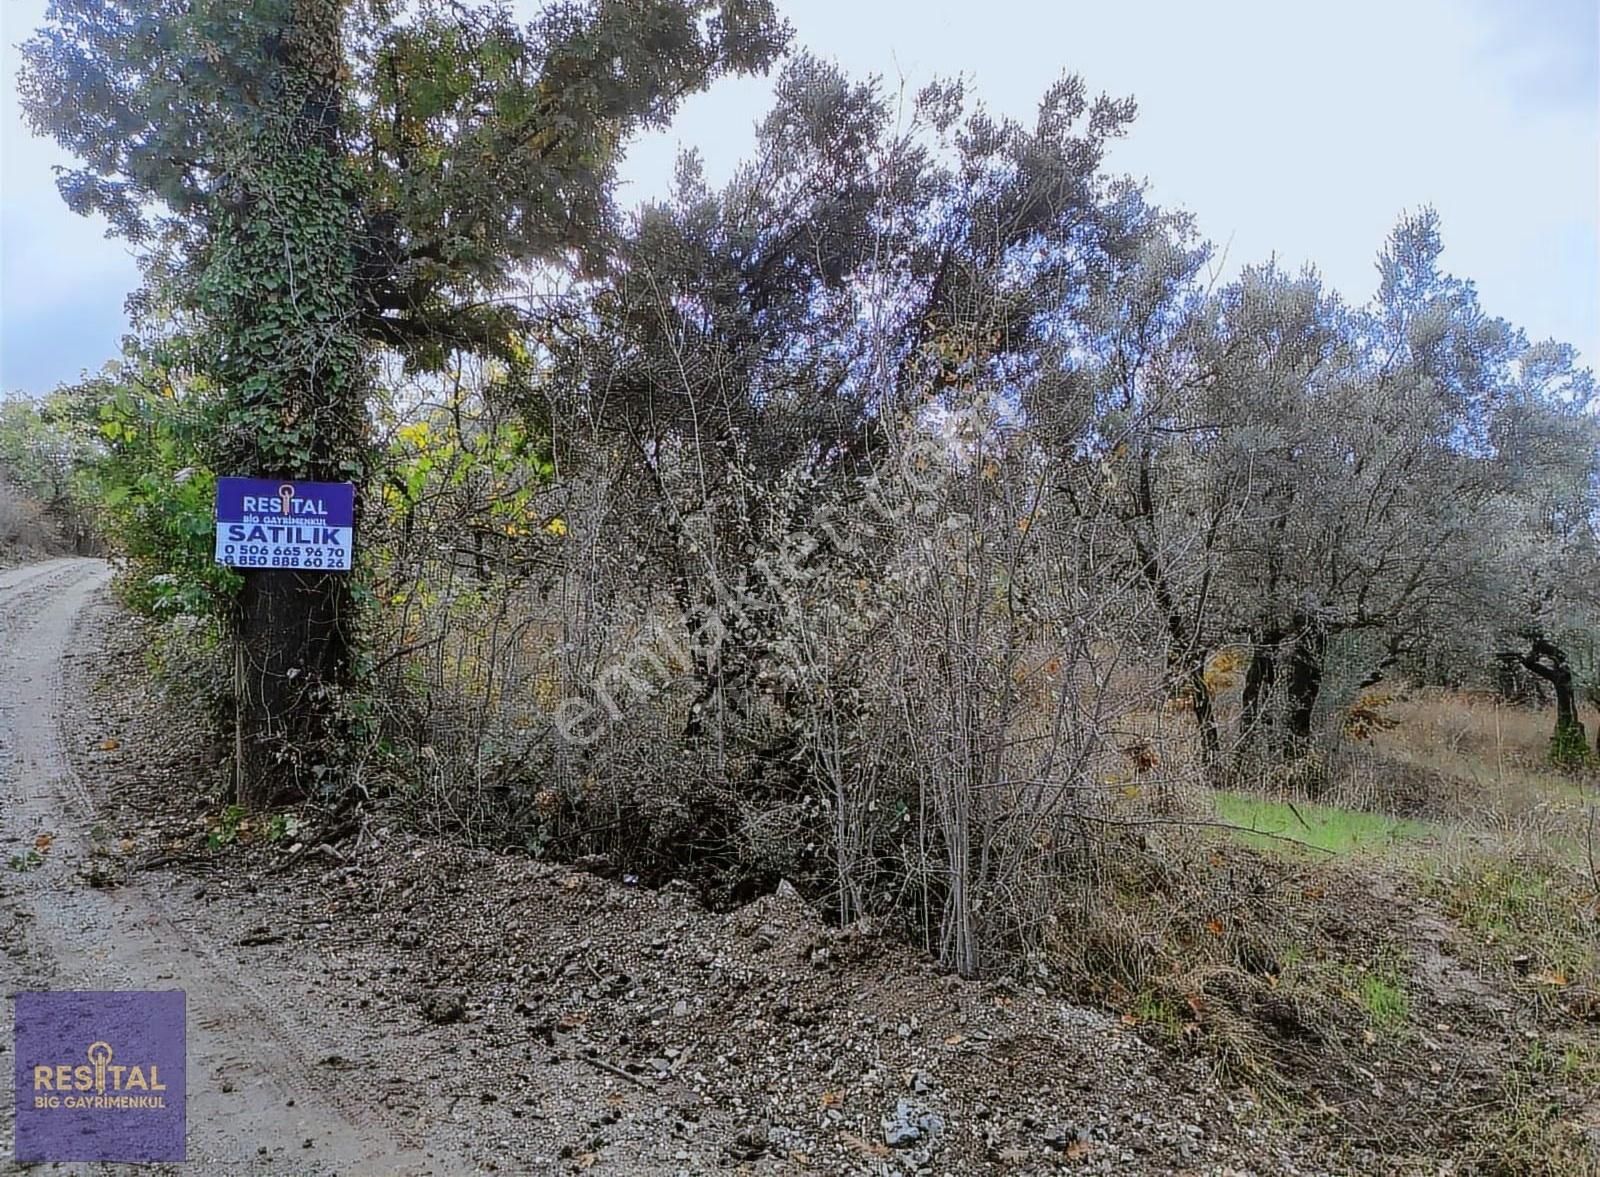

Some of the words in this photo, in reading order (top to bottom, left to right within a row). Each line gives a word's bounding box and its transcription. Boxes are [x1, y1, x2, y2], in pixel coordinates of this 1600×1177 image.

[228, 525, 341, 545] SATILIK
[225, 545, 235, 555] 0
[239, 545, 269, 555] 506
[273, 546, 301, 556] 665
[305, 547, 323, 557] 96
[327, 548, 345, 557] 70
[239, 556, 267, 566] 850
[272, 557, 300, 566] 888
[304, 558, 323, 568] 60
[327, 558, 345, 568] 26
